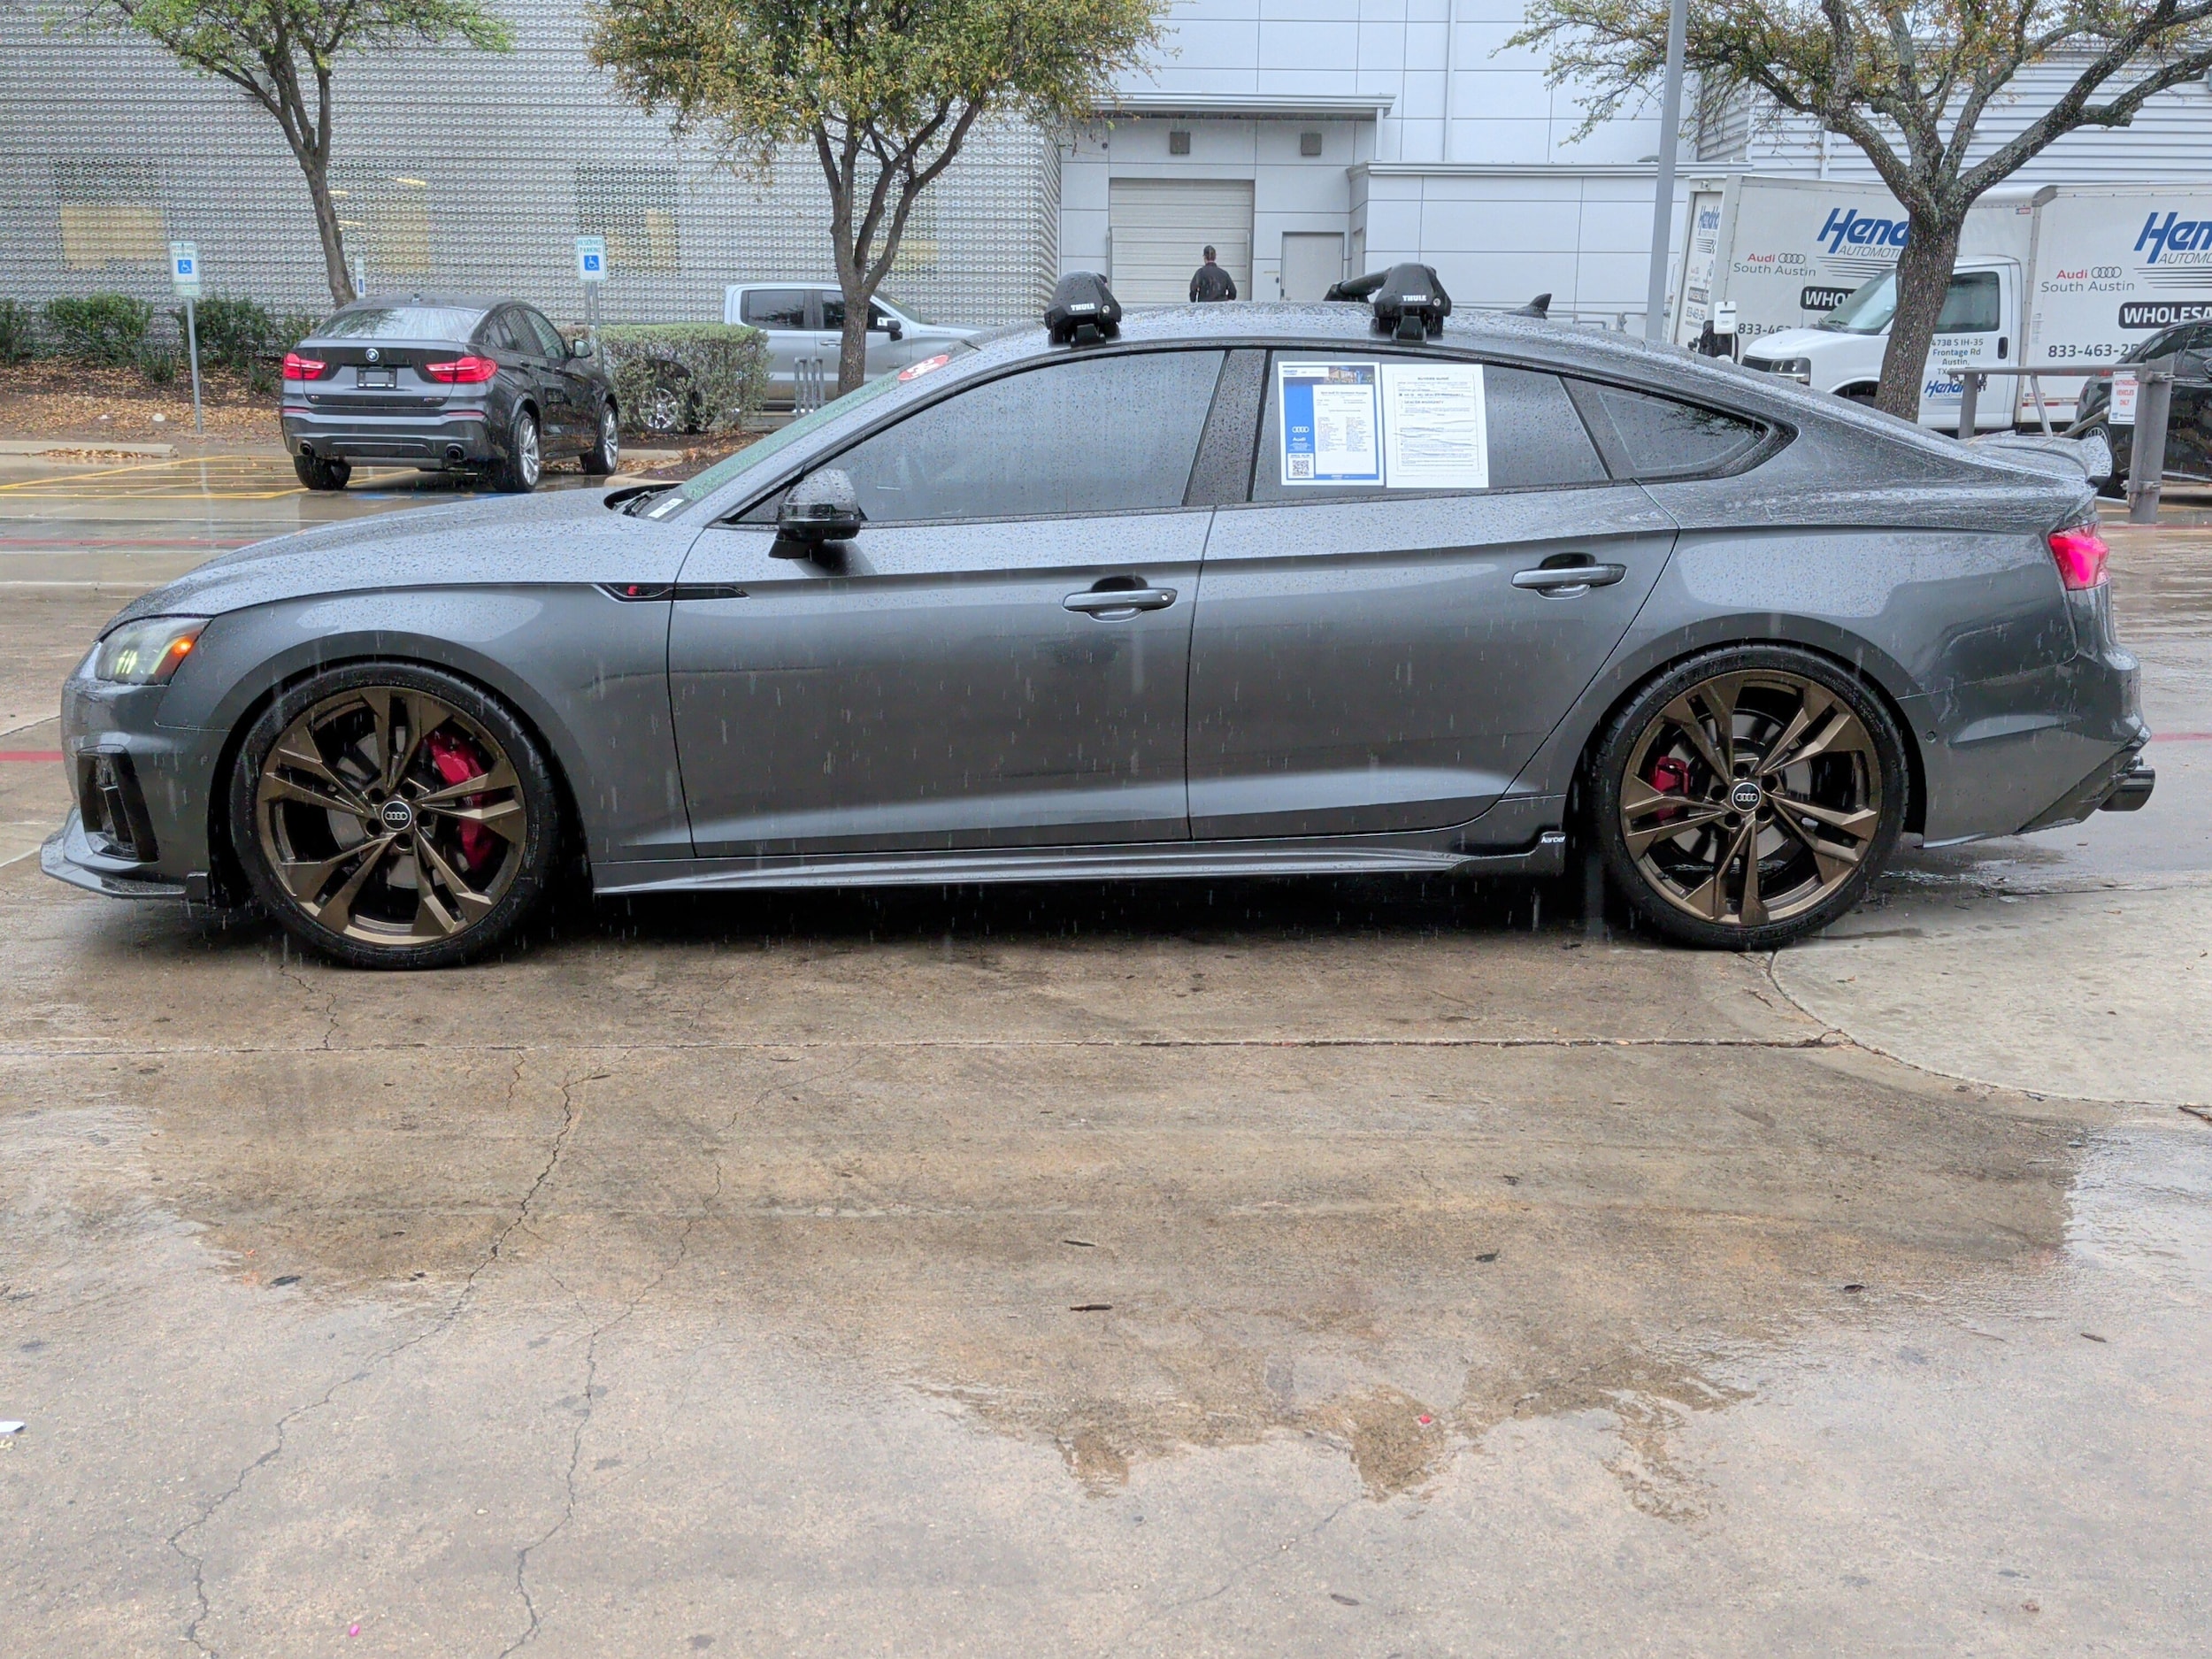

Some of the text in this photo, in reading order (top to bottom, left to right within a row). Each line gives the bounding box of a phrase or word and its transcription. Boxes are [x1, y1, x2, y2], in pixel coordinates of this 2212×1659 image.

[2133, 211, 2212, 264] Hen
[1747, 253, 1775, 263] Audi
[1838, 245, 1900, 258] AUTOMOTI
[1733, 262, 1816, 276] South Austin
[2056, 269, 2088, 279] Audi
[2040, 280, 2135, 293] South Austin
[1805, 290, 1850, 307] WHO
[1738, 323, 1792, 336] 833-46
[1932, 349, 1969, 357] Frontage
